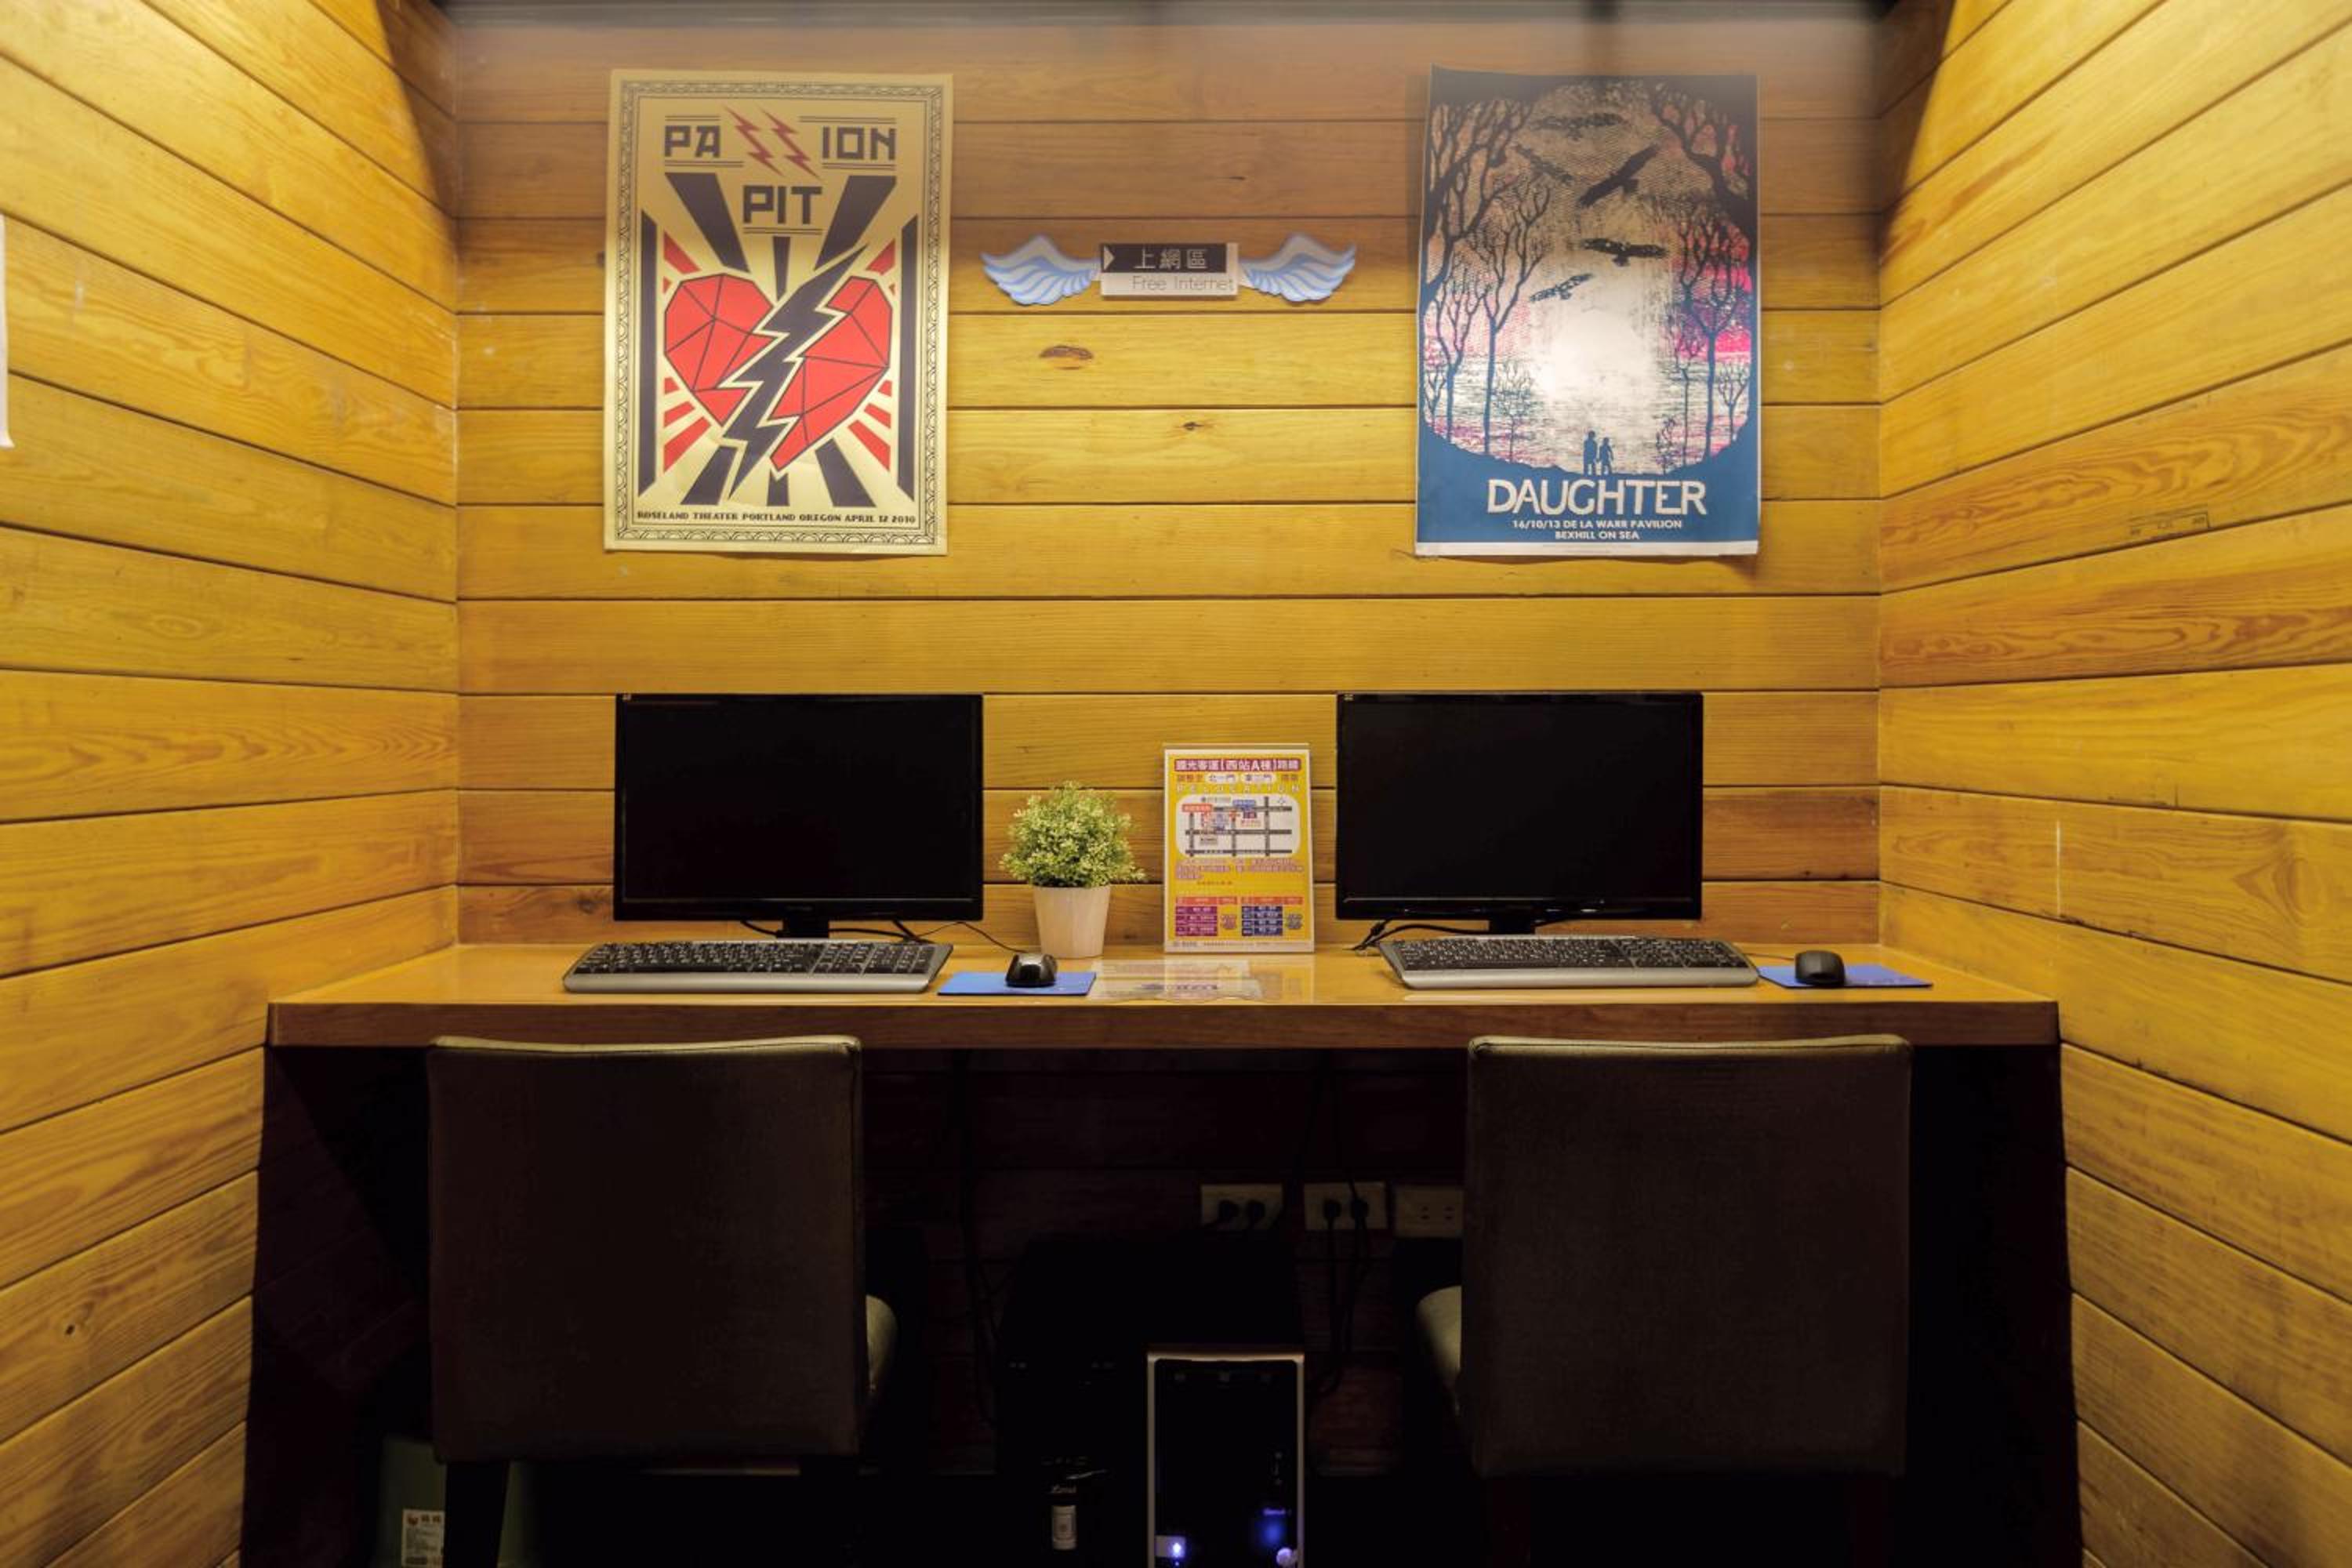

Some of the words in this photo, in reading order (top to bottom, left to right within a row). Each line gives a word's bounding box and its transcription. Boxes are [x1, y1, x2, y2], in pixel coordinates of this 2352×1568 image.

[742, 184, 823, 225] PIT
[1133, 246, 1208, 270] 上網區
[1131, 275, 1167, 291] Free
[1174, 275, 1234, 292] Internet
[1486, 477, 1708, 516] DAUGHTER
[637, 510, 690, 521] ROSELAND
[693, 511, 739, 521] THEATER
[742, 512, 796, 522] PORTLAND
[798, 514, 842, 523] OREGON
[844, 514, 875, 524] APRIL
[878, 514, 890, 524] 12
[891, 514, 916, 524] 2010
[1512, 519, 1561, 531] 16/10/13
[1563, 519, 1578, 530] DE
[1579, 519, 1595, 530] LA
[1595, 519, 1629, 530] WARR
[1630, 519, 1682, 530] PAVILION
[1555, 530, 1597, 541] BEXHILL
[1598, 530, 1617, 541] ON
[1618, 530, 1640, 541] SEA
